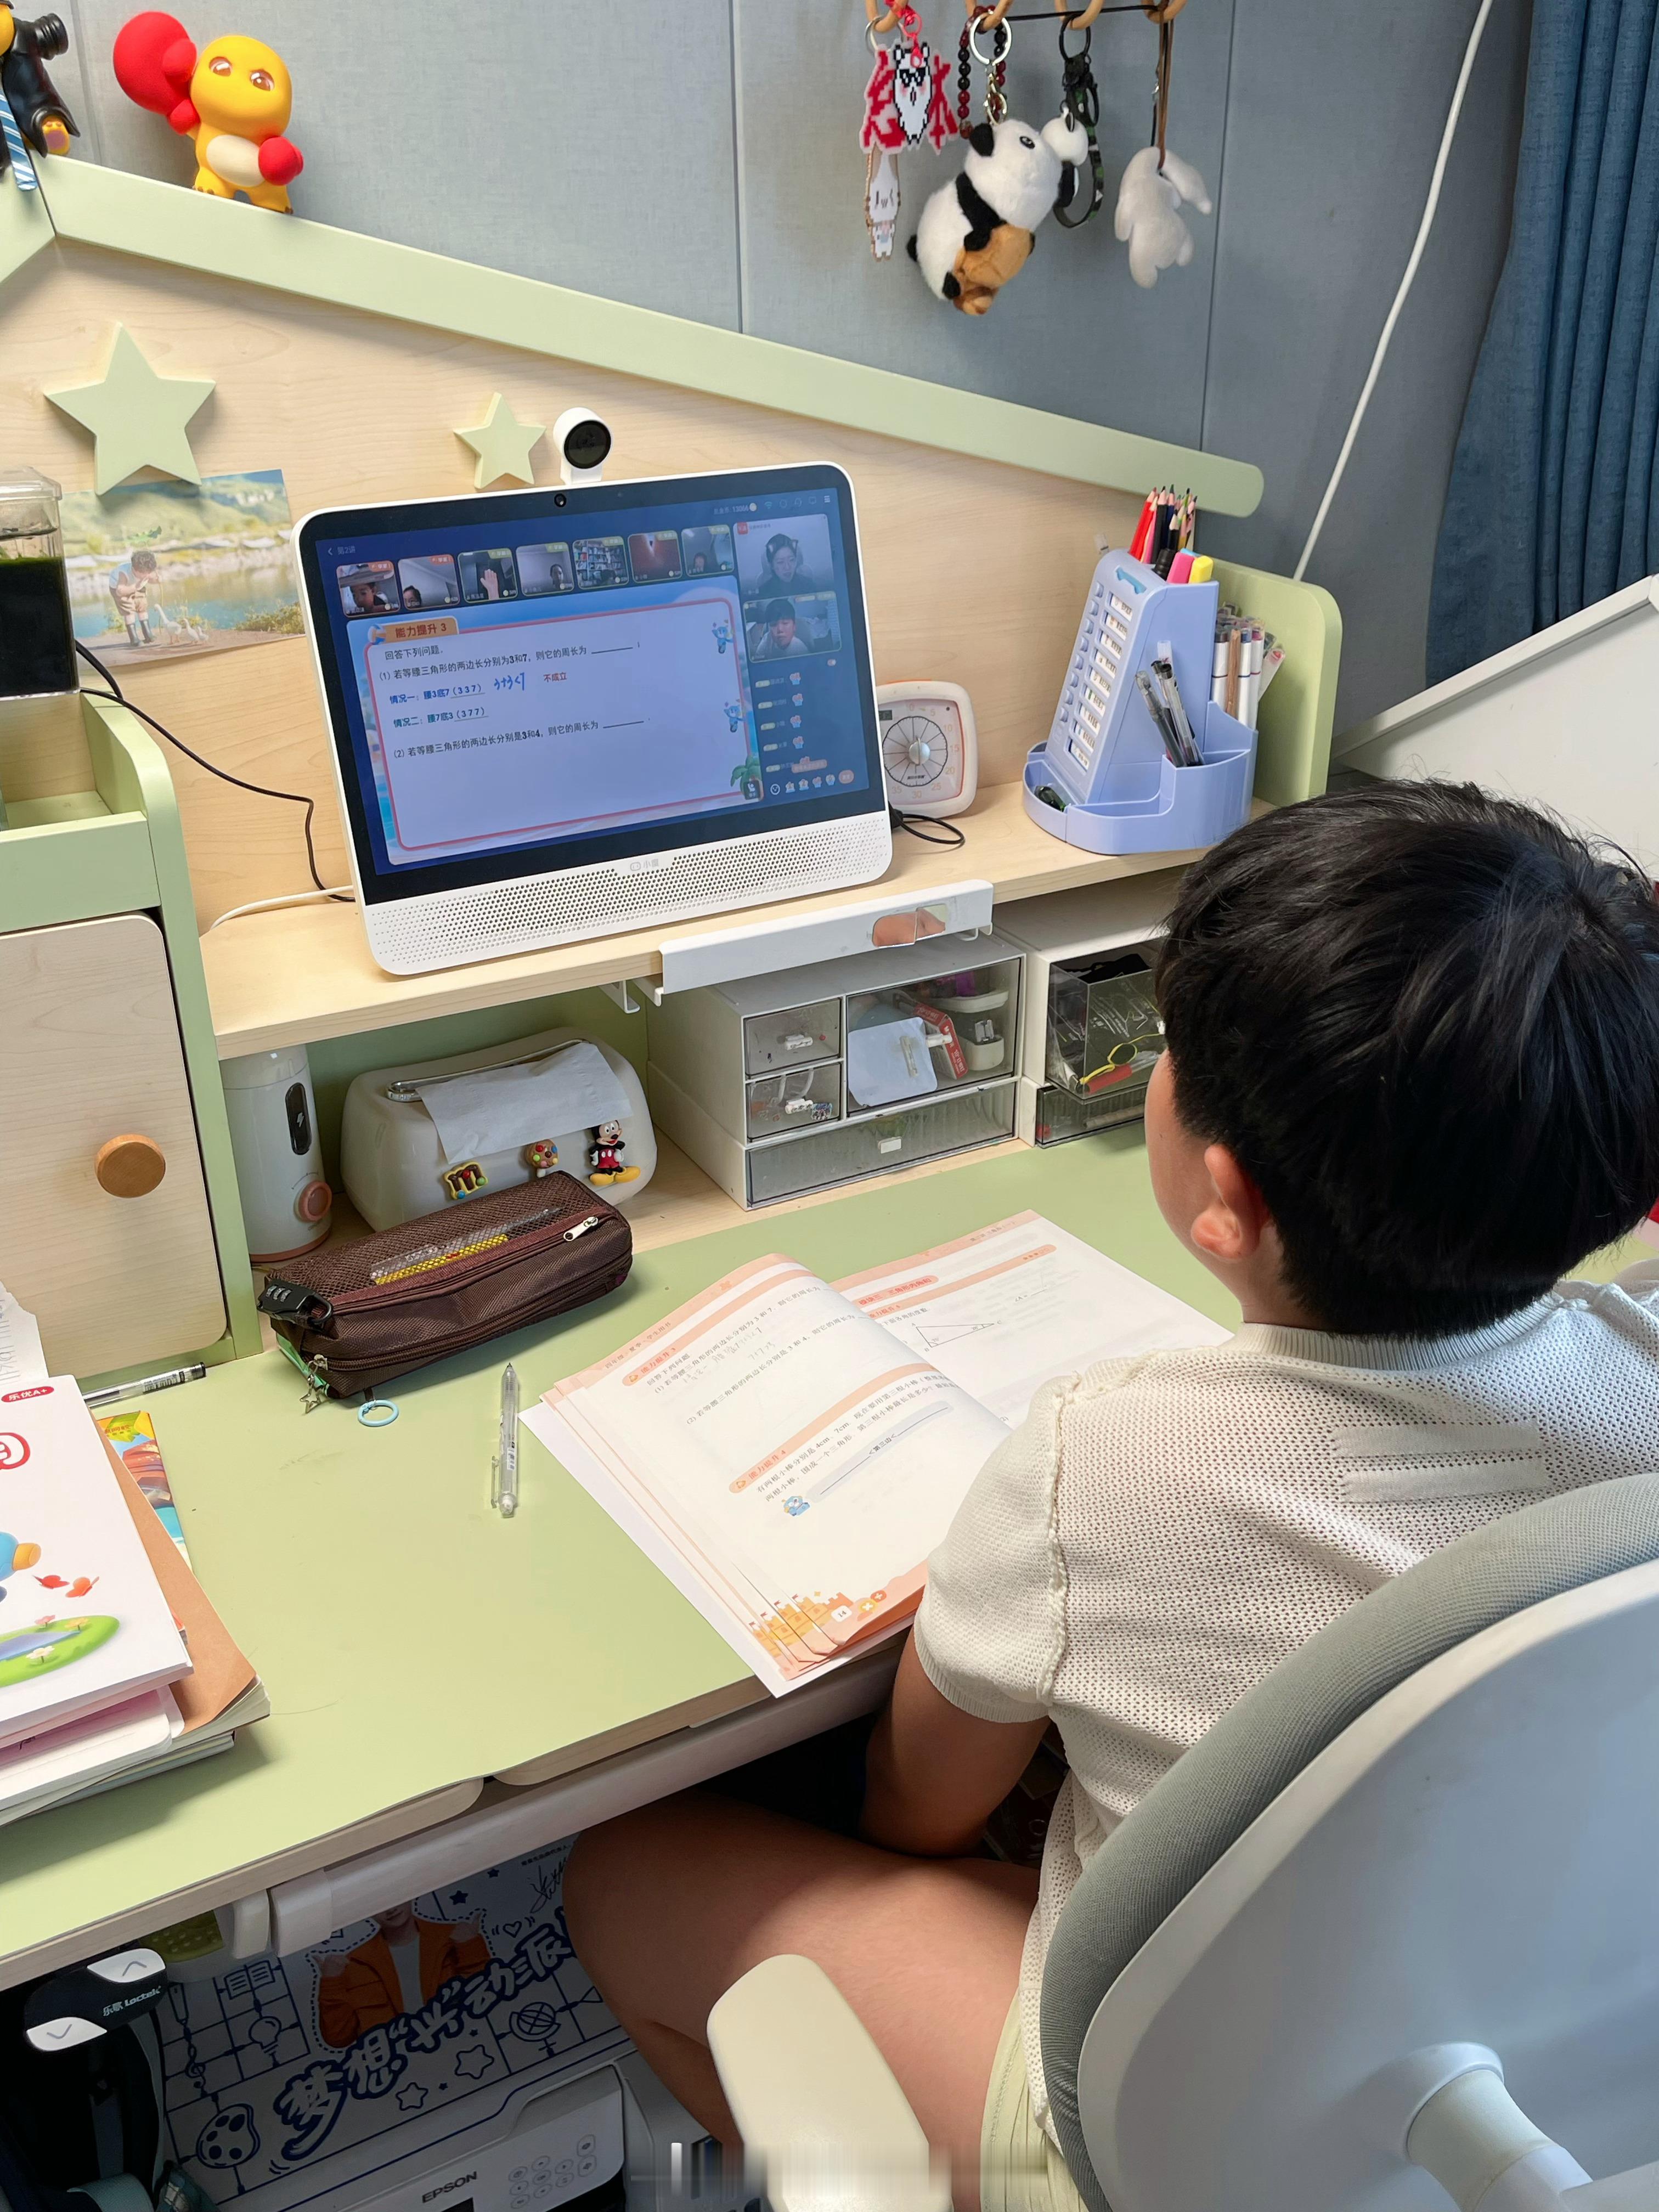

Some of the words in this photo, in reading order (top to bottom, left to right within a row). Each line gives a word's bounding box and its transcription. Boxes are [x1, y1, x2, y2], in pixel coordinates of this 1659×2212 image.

[395, 624, 437, 638] 能力提升
[441, 623, 447, 631] 3
[543, 672, 567, 682] 不成立
[944, 724, 953, 732] 10
[950, 744, 960, 753] 15
[945, 766, 955, 775] 20
[891, 786, 902, 794] 35
[932, 782, 942, 791] 25
[912, 791, 922, 799] 30
[888, 1277, 932, 1295] 三角形内角和
[640, 1351, 670, 1374] 能力提升
[748, 1454, 780, 1480] 能力提升
[837, 1609, 848, 1619] 14
[422, 2170, 477, 2203] EPSON
